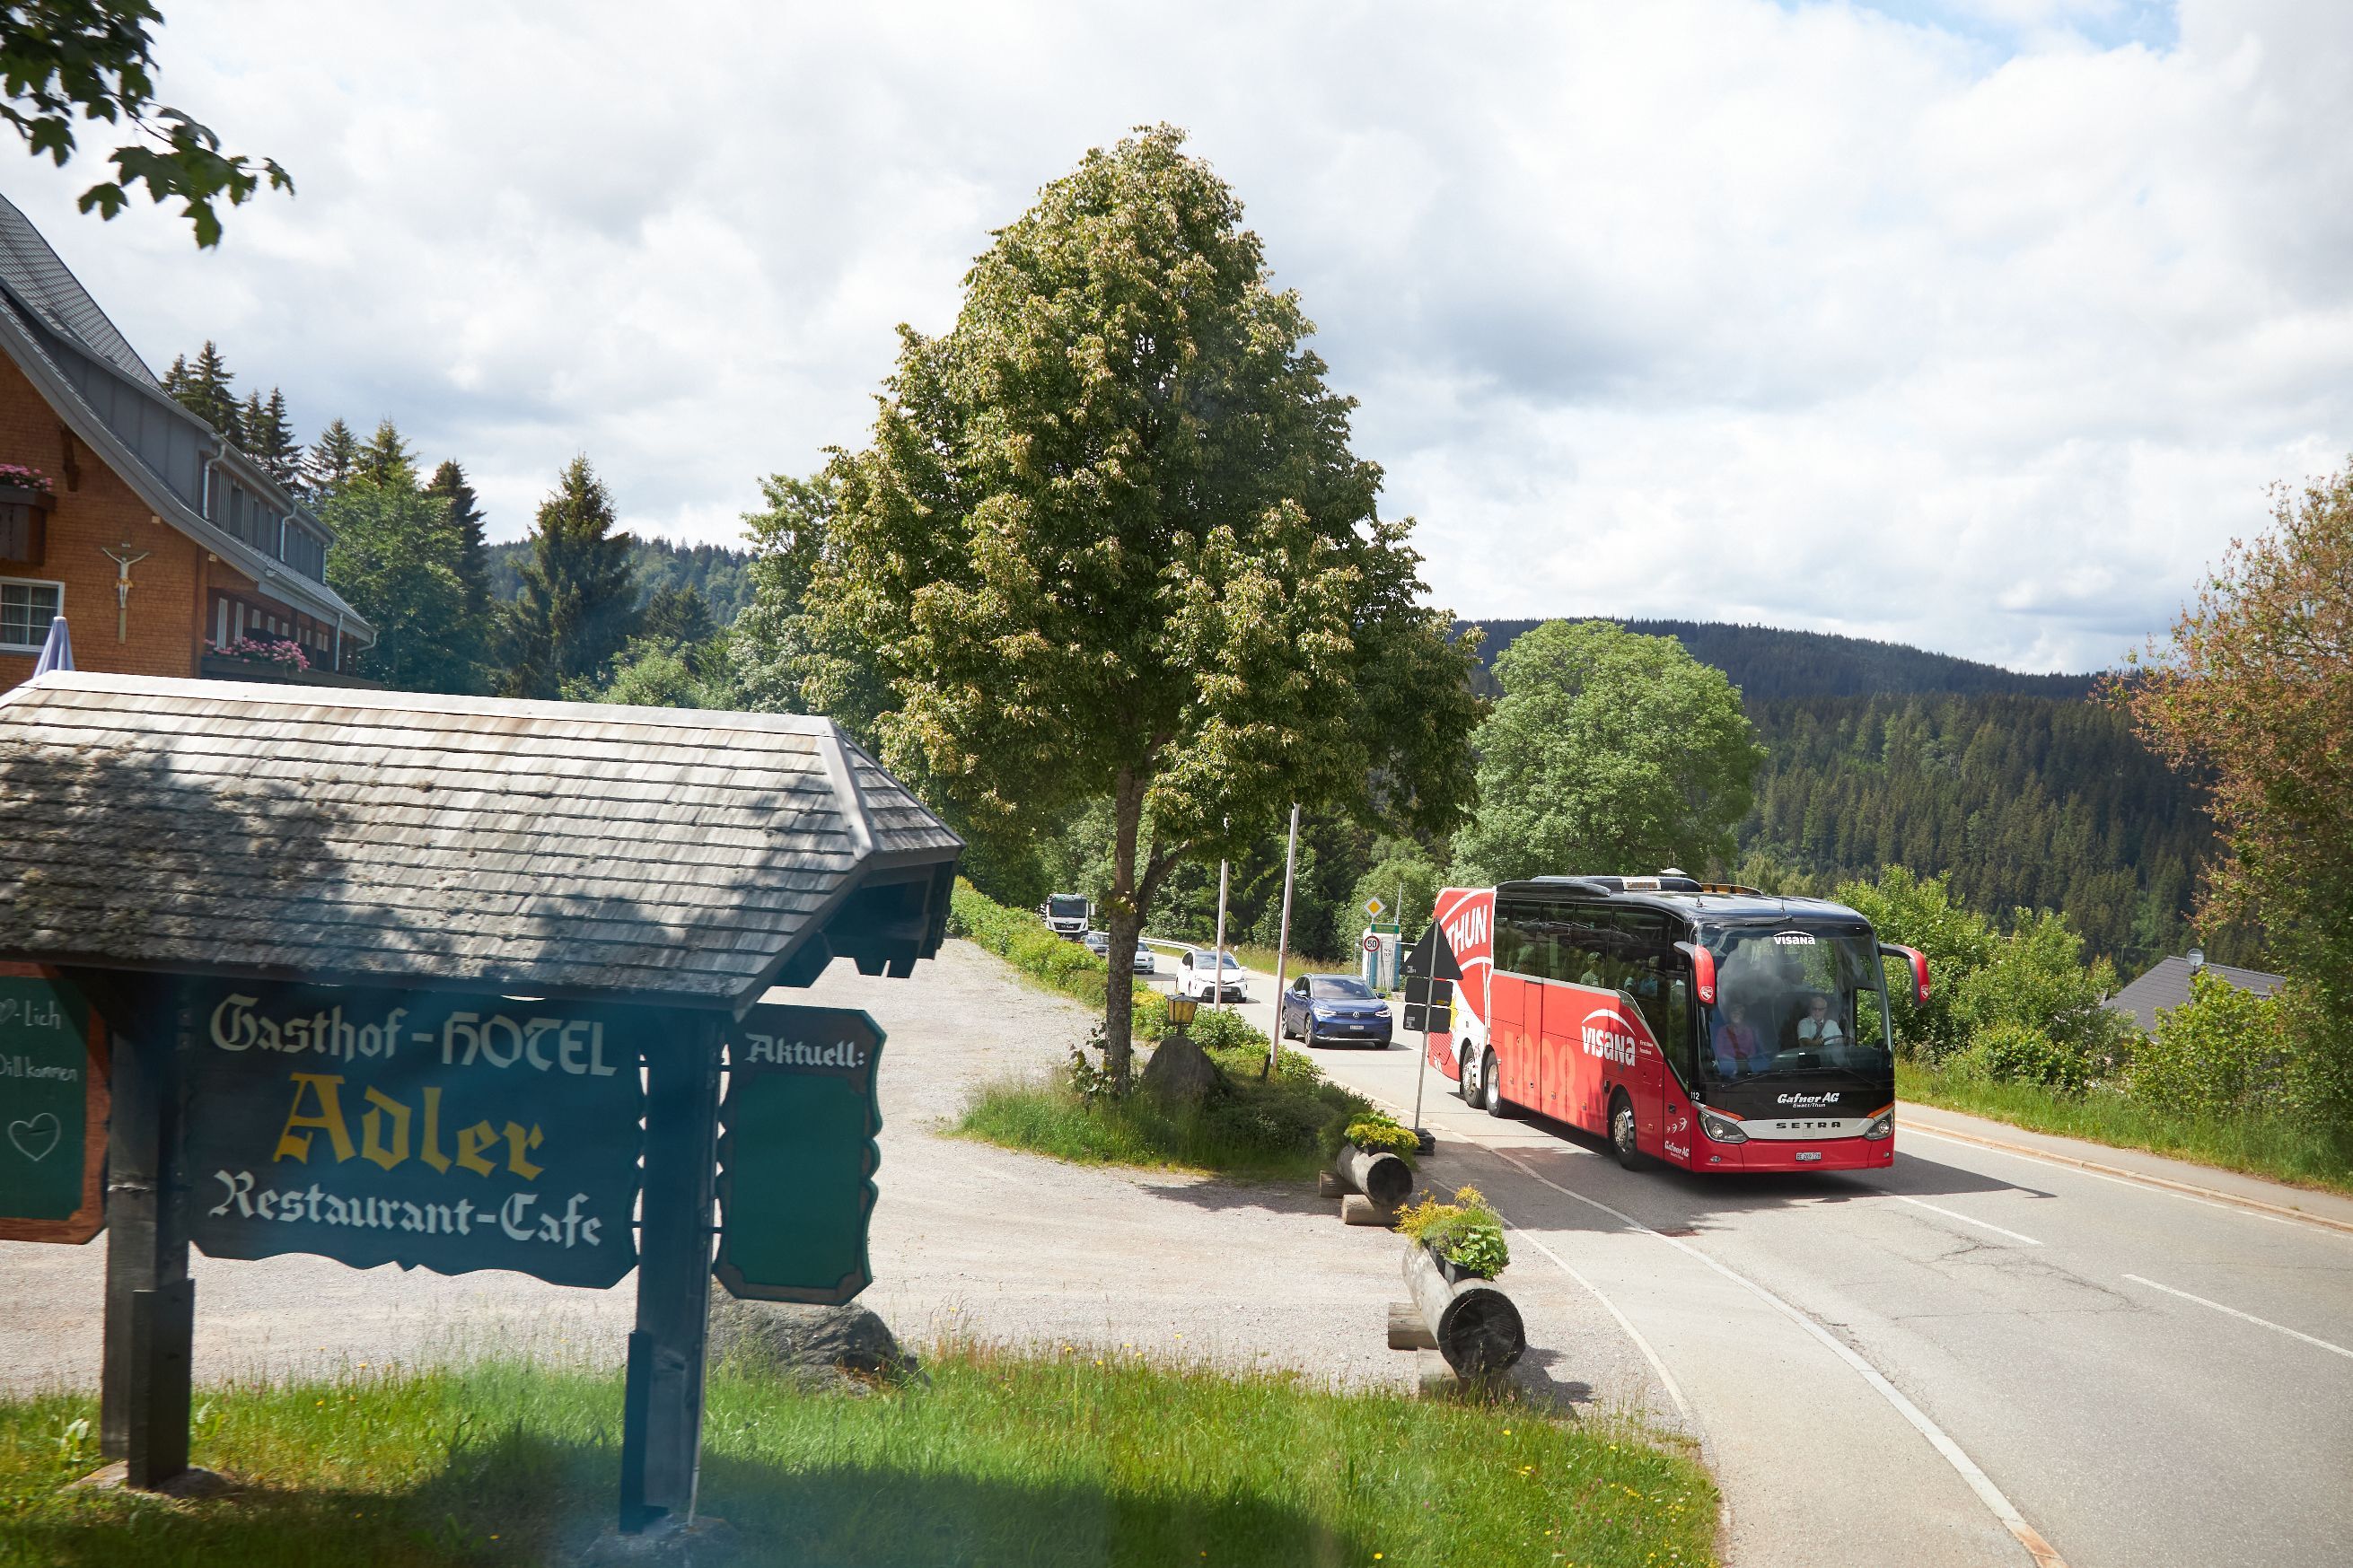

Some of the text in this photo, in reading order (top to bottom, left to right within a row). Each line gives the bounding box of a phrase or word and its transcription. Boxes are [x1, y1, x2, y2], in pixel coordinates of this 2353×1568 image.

[1446, 905, 1488, 958] THUN
[1367, 940, 1377, 948] 50
[743, 1032, 865, 1068] Aktuell:
[1778, 1091, 1840, 1104] Gafner AG
[273, 1072, 545, 1181] Adler
[1776, 1121, 1841, 1129] SETRA
